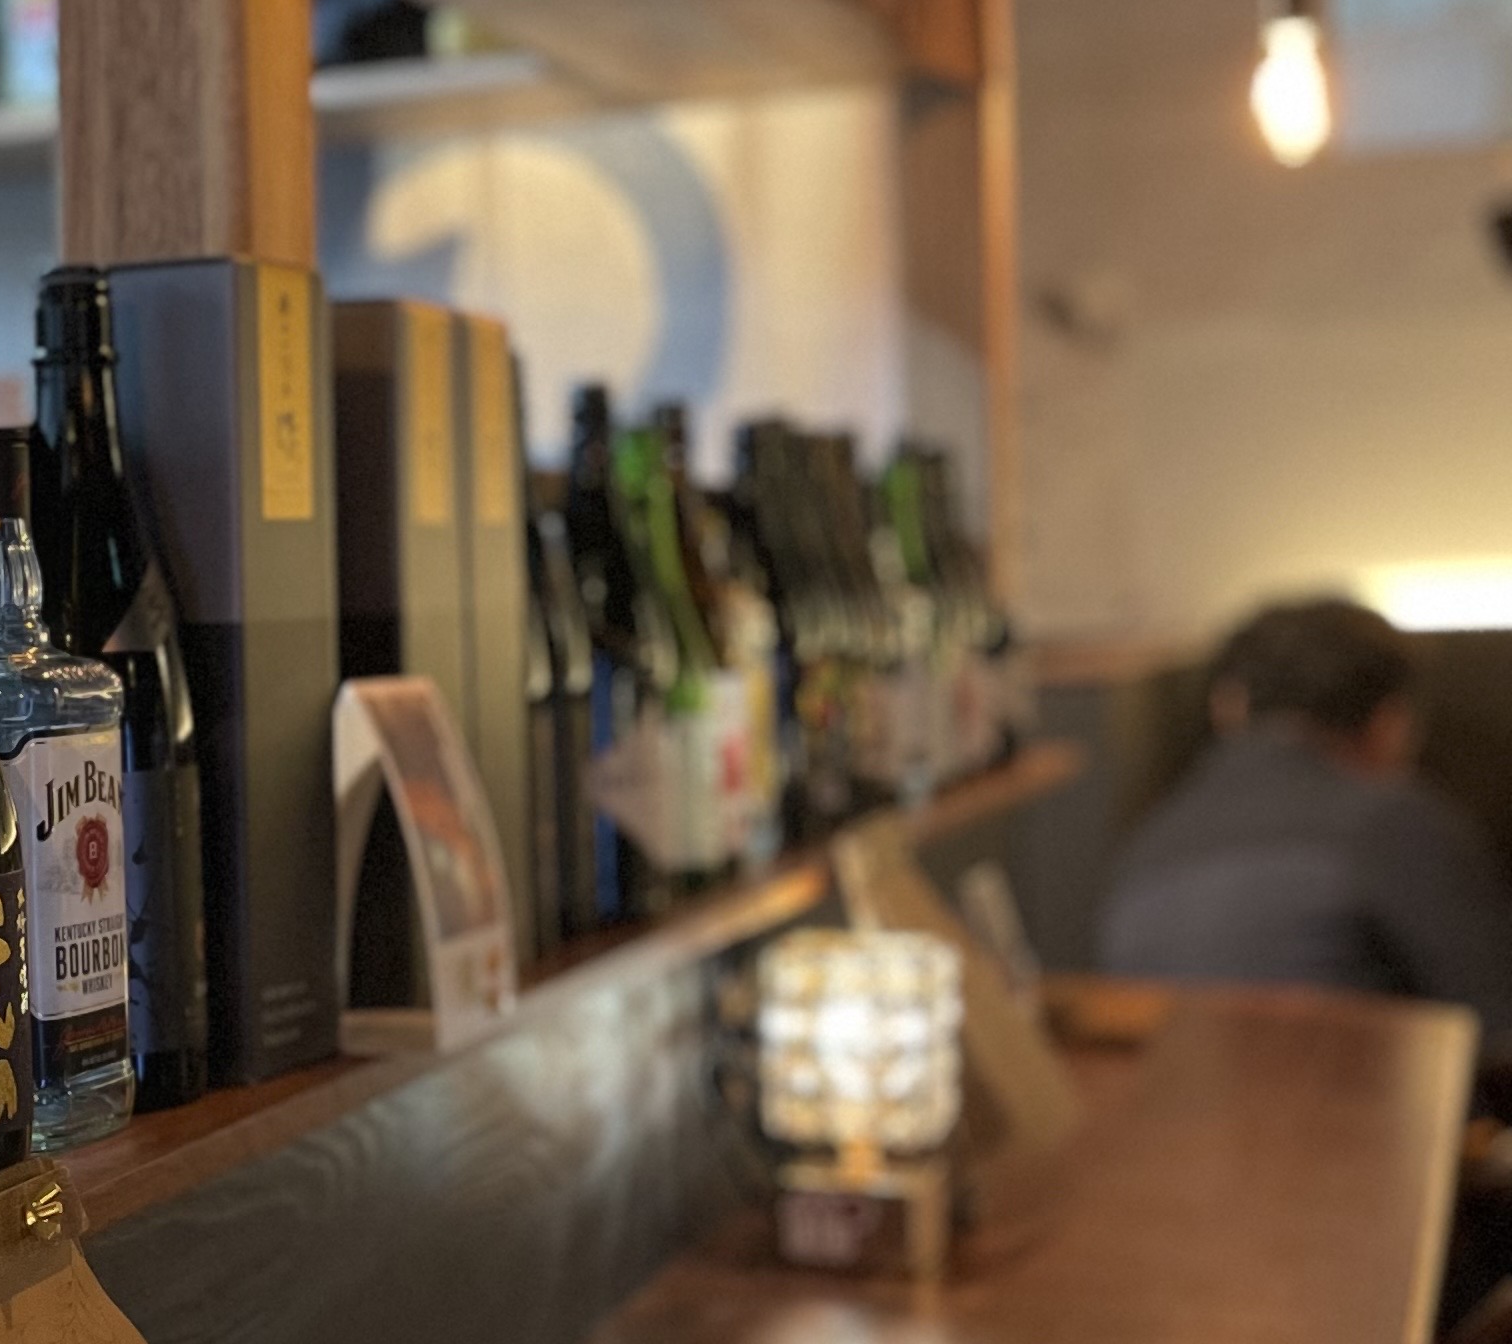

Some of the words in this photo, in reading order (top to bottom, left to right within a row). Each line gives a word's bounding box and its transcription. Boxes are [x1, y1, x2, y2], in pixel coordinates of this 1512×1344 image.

[36, 773, 80, 842] JIM
[54, 919, 96, 943] KENTUCKY
[82, 973, 113, 995] WHISKEY
